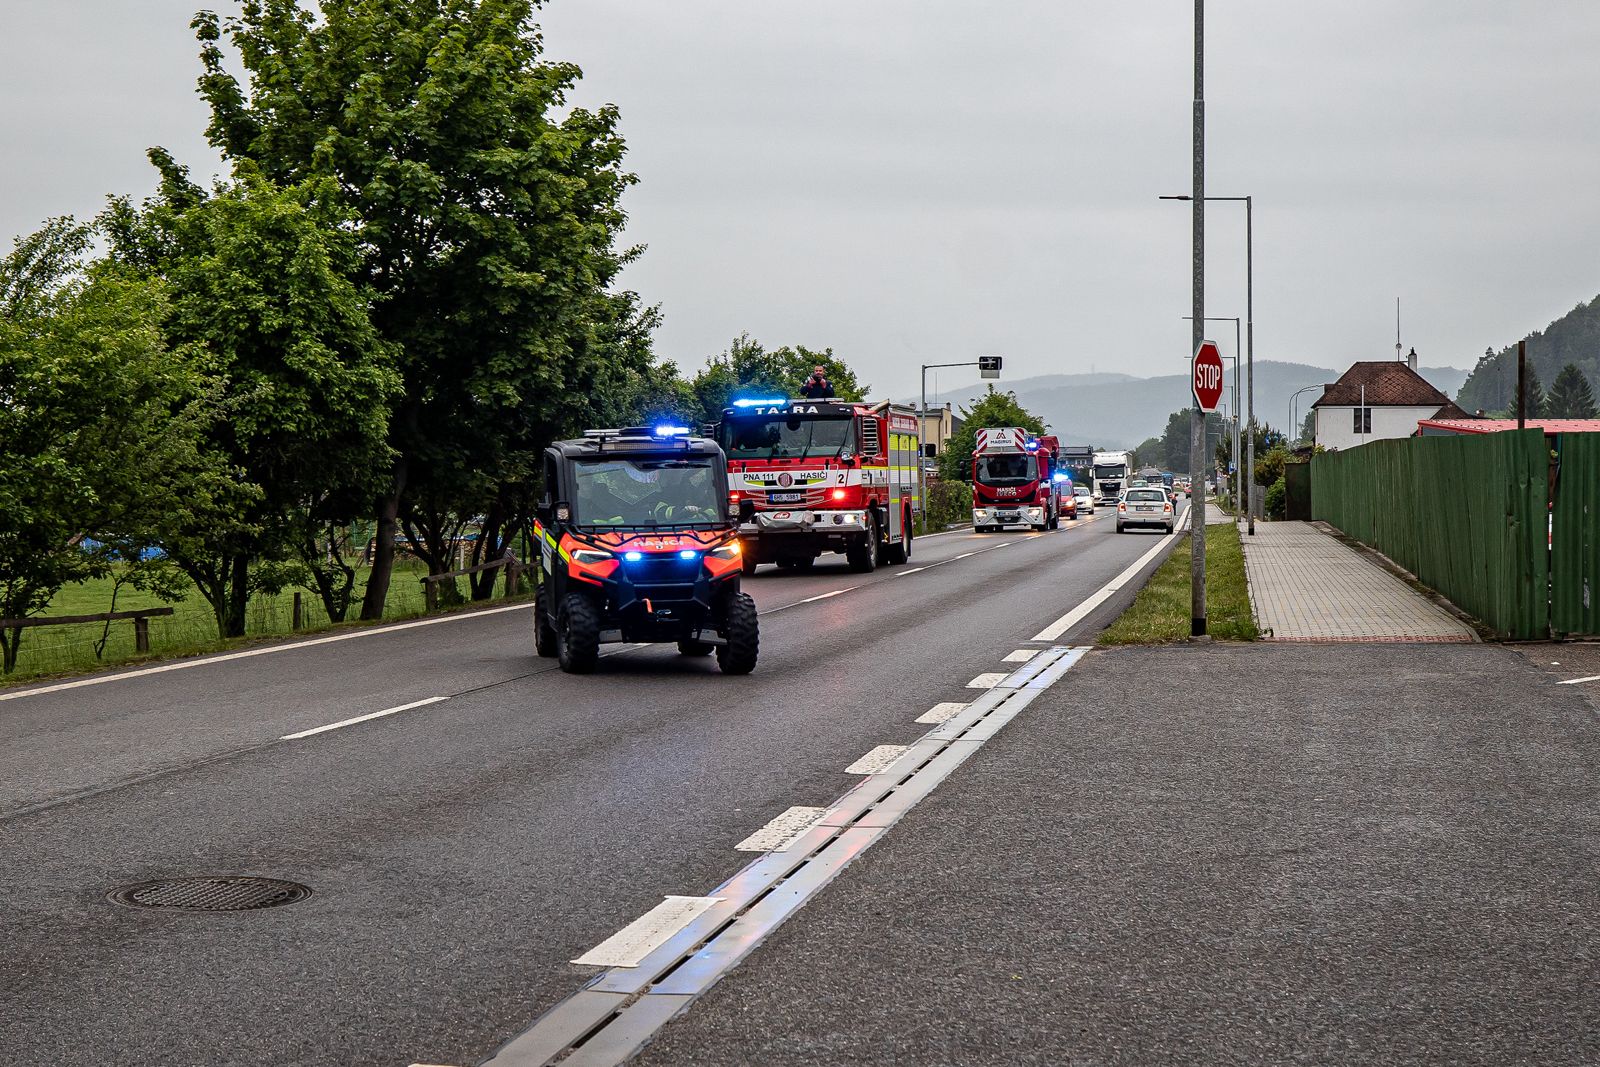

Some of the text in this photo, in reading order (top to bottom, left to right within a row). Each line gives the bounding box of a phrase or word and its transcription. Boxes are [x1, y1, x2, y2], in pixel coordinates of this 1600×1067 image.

[1196, 363, 1221, 390] STOP
[743, 473, 761, 481] PNA
[800, 471, 828, 479] HASIČI
[838, 473, 845, 484] 2
